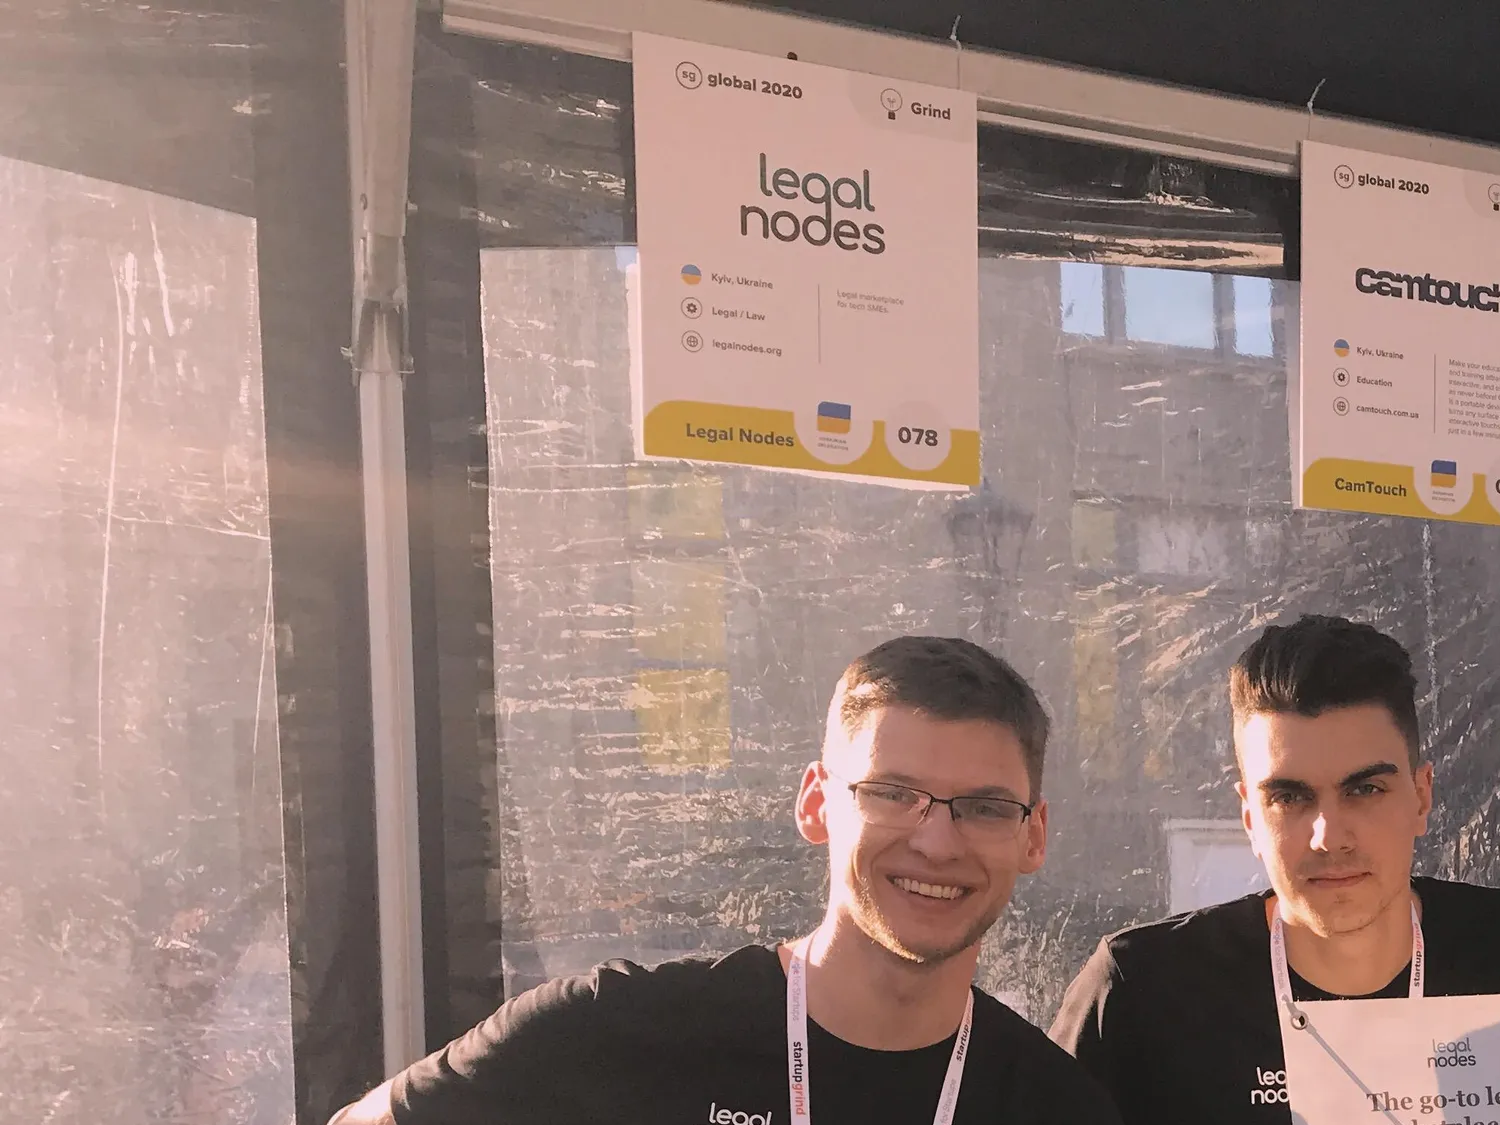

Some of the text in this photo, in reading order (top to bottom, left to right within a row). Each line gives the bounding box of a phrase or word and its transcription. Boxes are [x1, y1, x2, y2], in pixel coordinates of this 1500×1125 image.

[707, 73, 803, 99] global 2020
[911, 101, 951, 121] Grind
[760, 153, 876, 212] legal
[1358, 174, 1429, 195] global 2020
[740, 204, 886, 255] nodes
[711, 273, 773, 289] Kyiv, Ukraine
[712, 307, 765, 321] Legal Law
[712, 339, 782, 356] legalnodes.org
[1356, 347, 1404, 360] Kyiv, Ukraine
[1356, 376, 1393, 388] Education
[1356, 405, 1419, 419] camtouch.com.ua
[686, 423, 733, 444] Legal
[739, 429, 794, 448] Nodes
[898, 426, 938, 447] 078
[1335, 478, 1407, 497] CamTouch
[1432, 1037, 1472, 1053] legal
[1427, 1053, 1476, 1068] nodes
[792, 1041, 806, 1116] startupgrind
[1366, 1091, 1413, 1113] The
[1420, 1090, 1481, 1115] go-to
